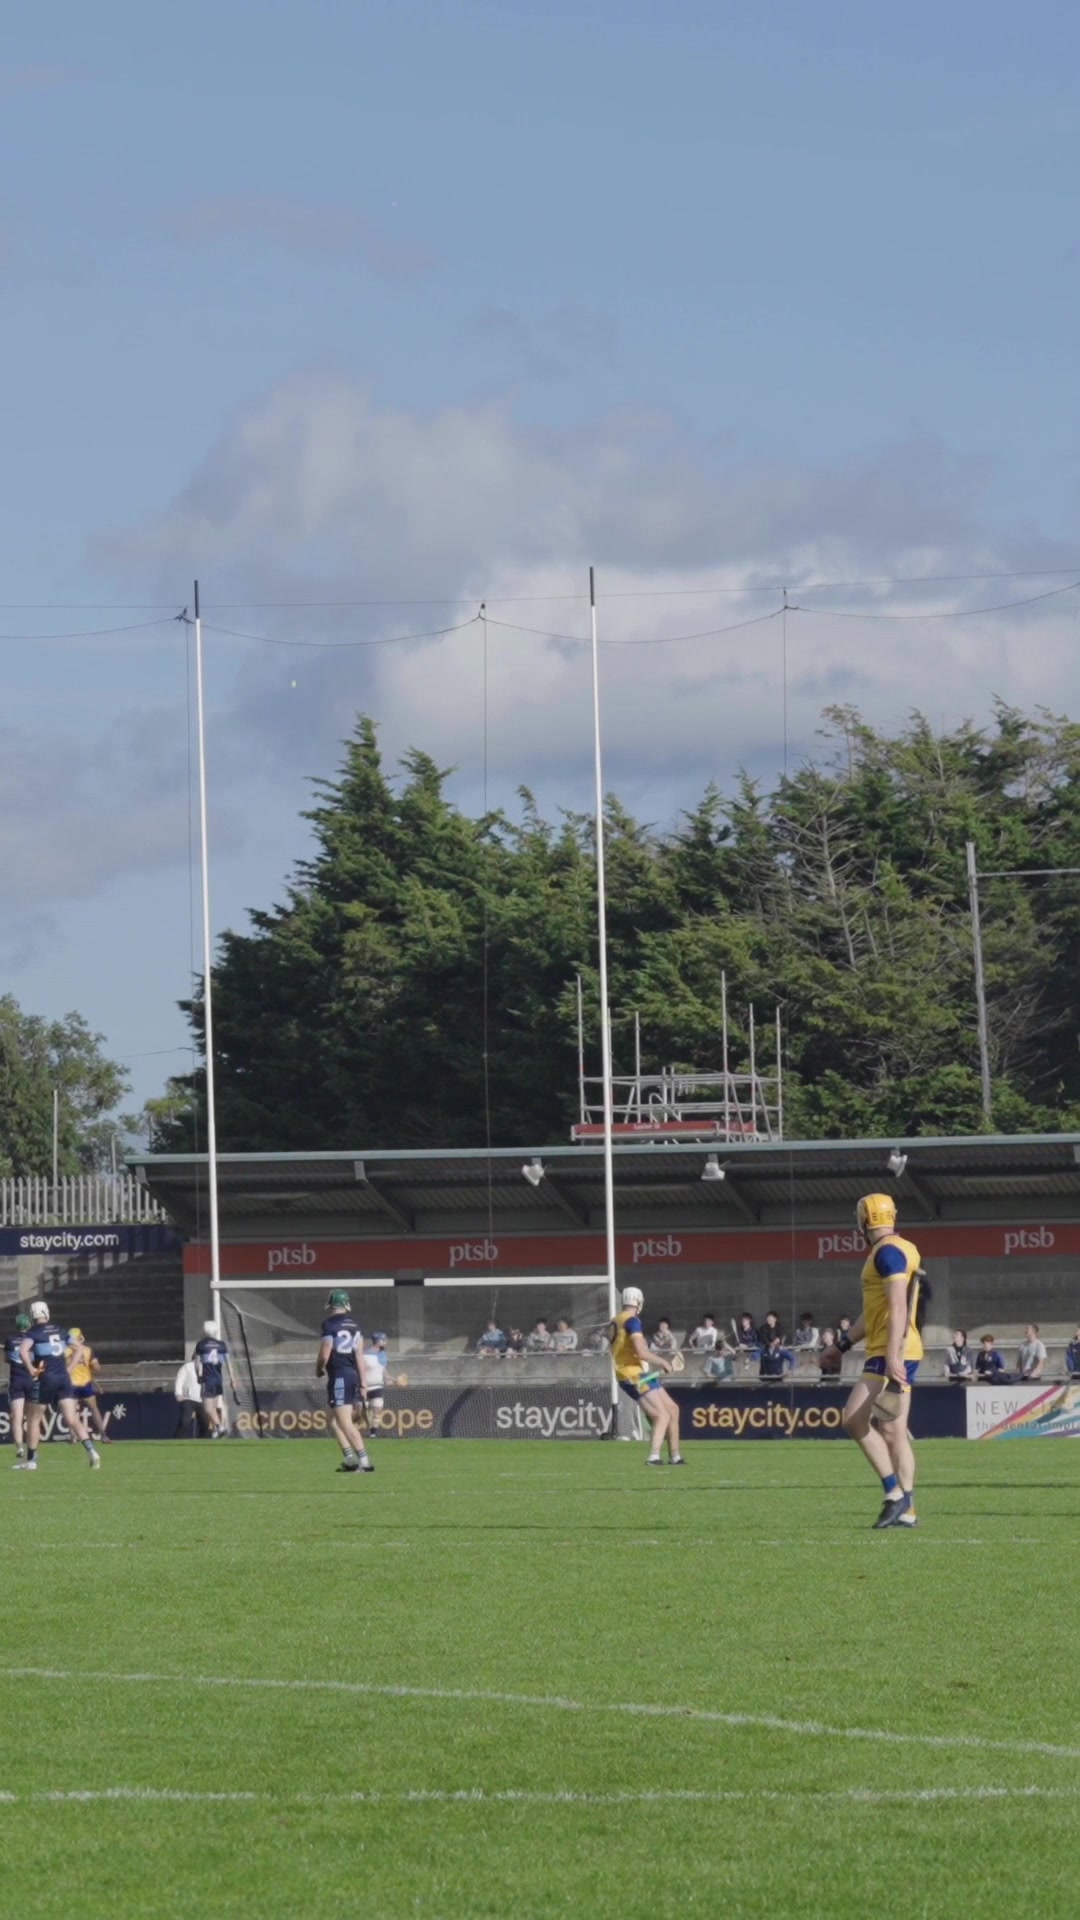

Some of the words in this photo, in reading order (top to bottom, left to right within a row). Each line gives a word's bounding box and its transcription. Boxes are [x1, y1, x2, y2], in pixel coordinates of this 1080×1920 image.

[20, 1231, 119, 1251] staycity.com
[449, 1239, 499, 1267] ptsb
[632, 1234, 682, 1263] ptsb
[818, 1230, 867, 1259] ptsb
[1004, 1226, 1055, 1255] ptsb
[268, 1243, 316, 1271] ptsb
[49, 1334, 63, 1356] 5
[236, 1409, 327, 1430] across
[496, 1399, 614, 1436] staycity
[692, 1401, 845, 1435] staycity.co
[975, 1401, 1018, 1415] NEW
